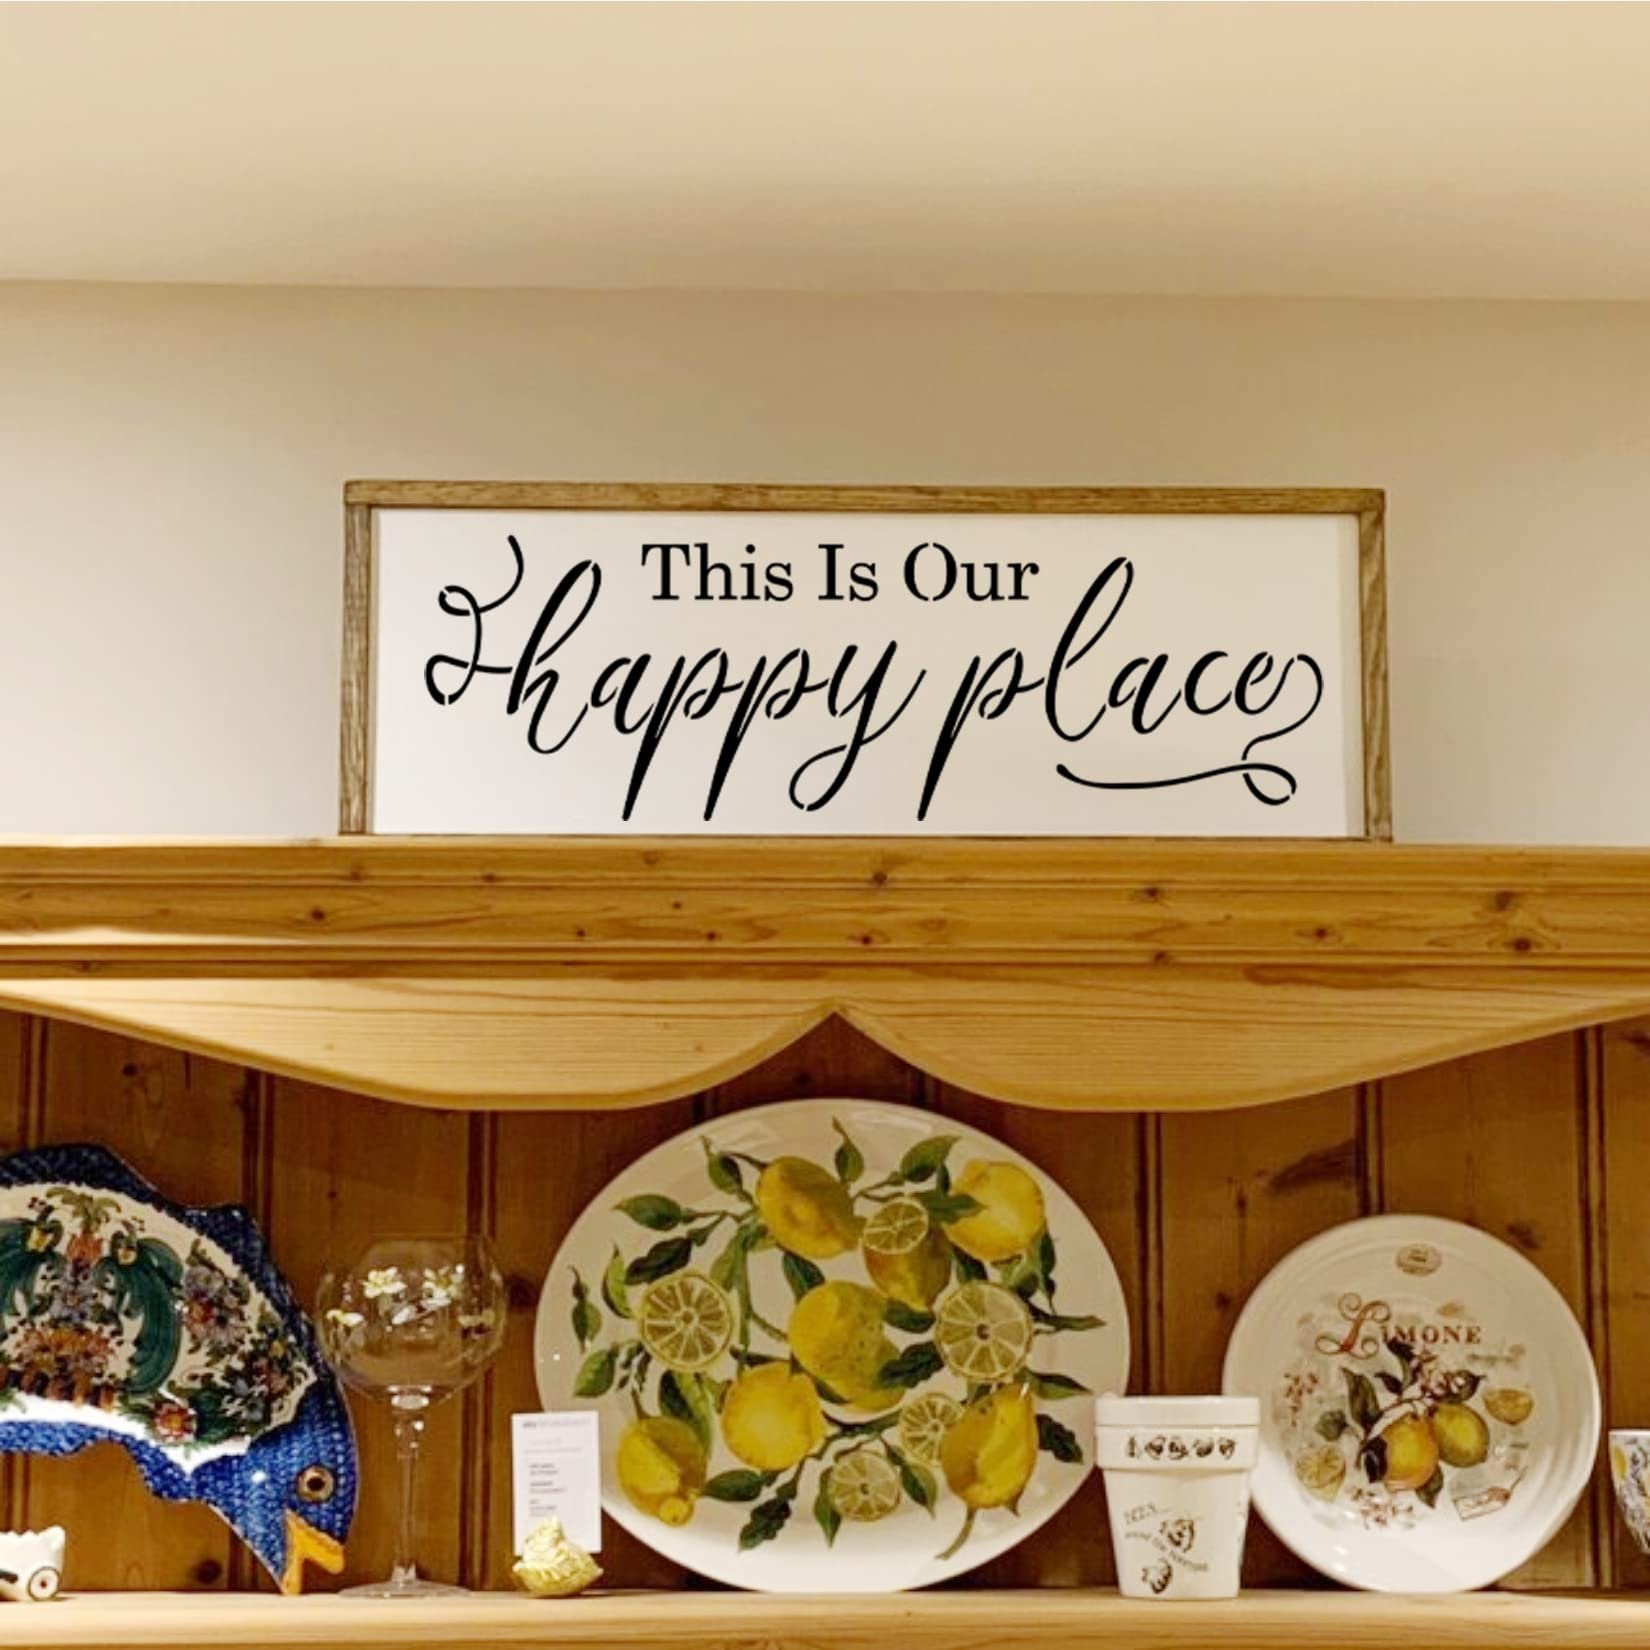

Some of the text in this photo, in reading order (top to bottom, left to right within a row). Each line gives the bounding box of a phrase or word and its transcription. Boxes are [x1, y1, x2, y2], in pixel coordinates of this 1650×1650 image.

[641, 542, 1040, 602] This Is Our
[424, 534, 1323, 822] happy place
